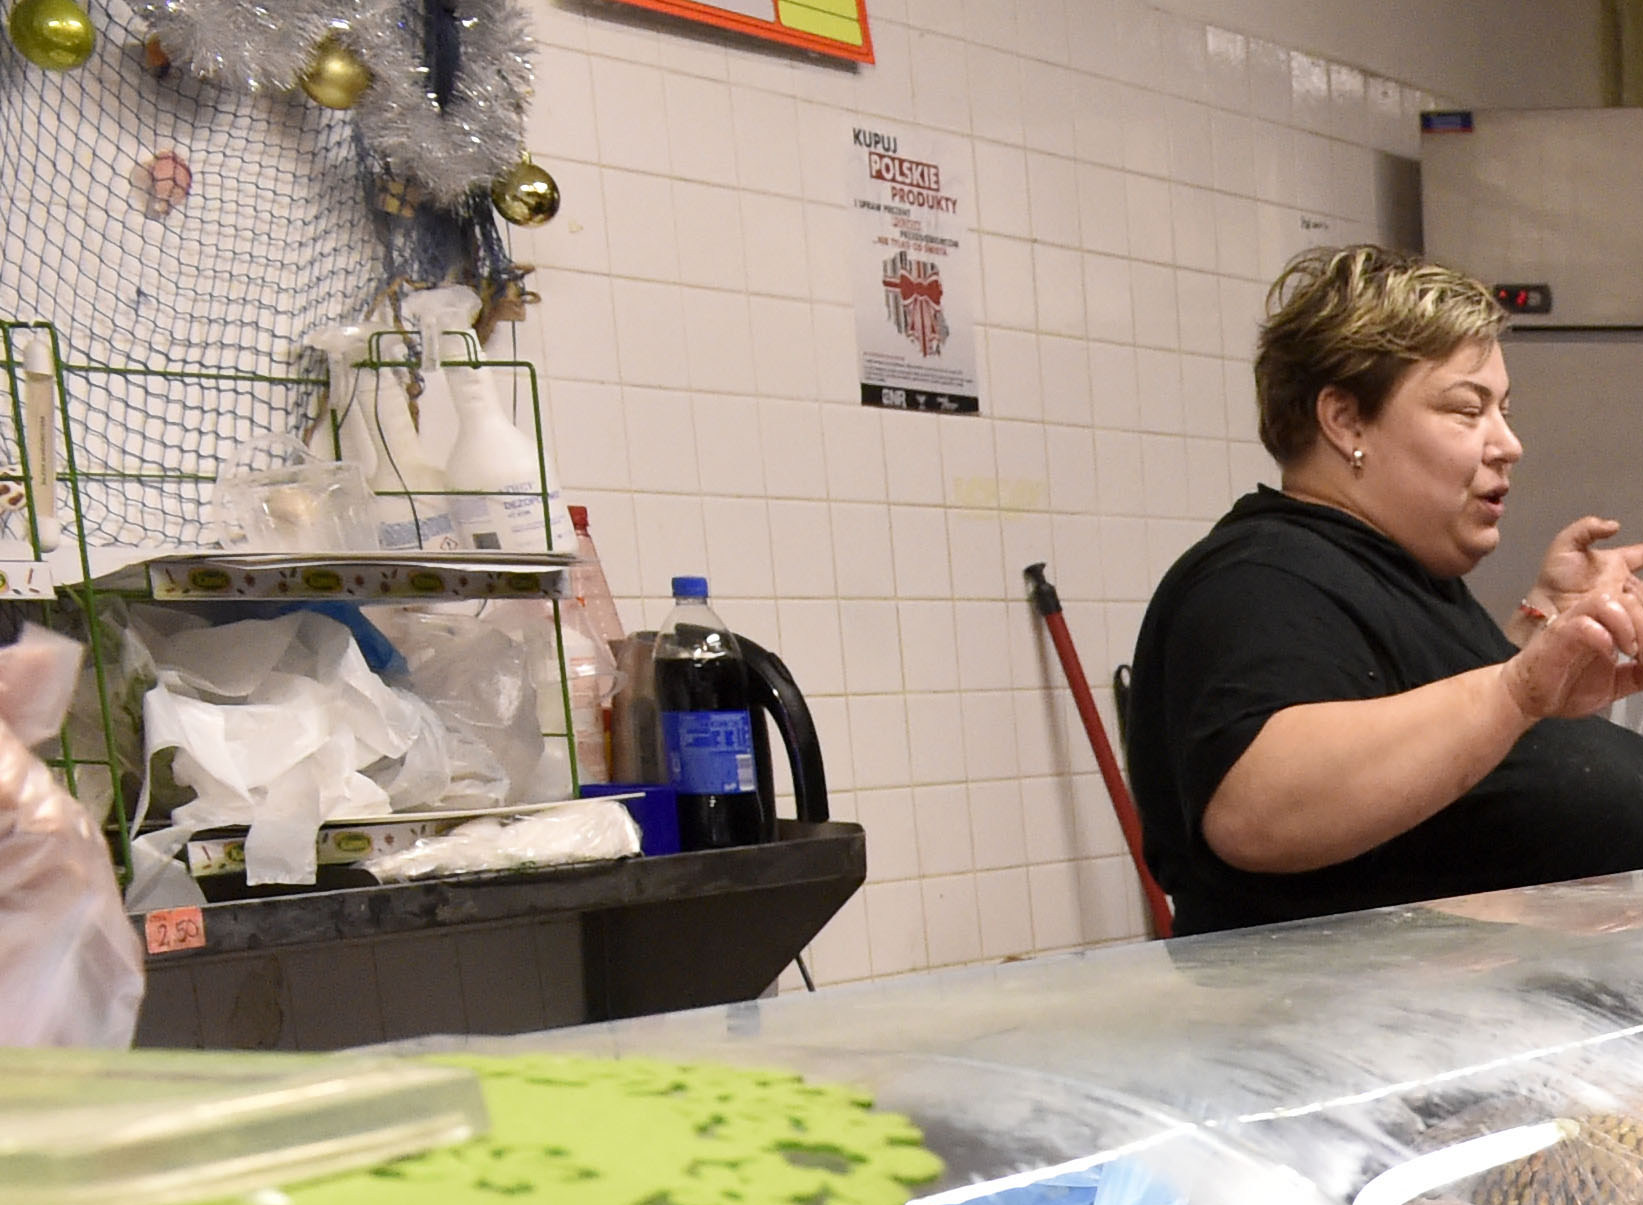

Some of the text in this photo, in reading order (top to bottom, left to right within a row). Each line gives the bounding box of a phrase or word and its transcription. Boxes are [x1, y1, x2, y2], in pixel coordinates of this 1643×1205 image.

[853, 127, 898, 154] KUPUJ
[870, 153, 939, 190] POLSKIE
[891, 186, 958, 214] PRODUKTY
